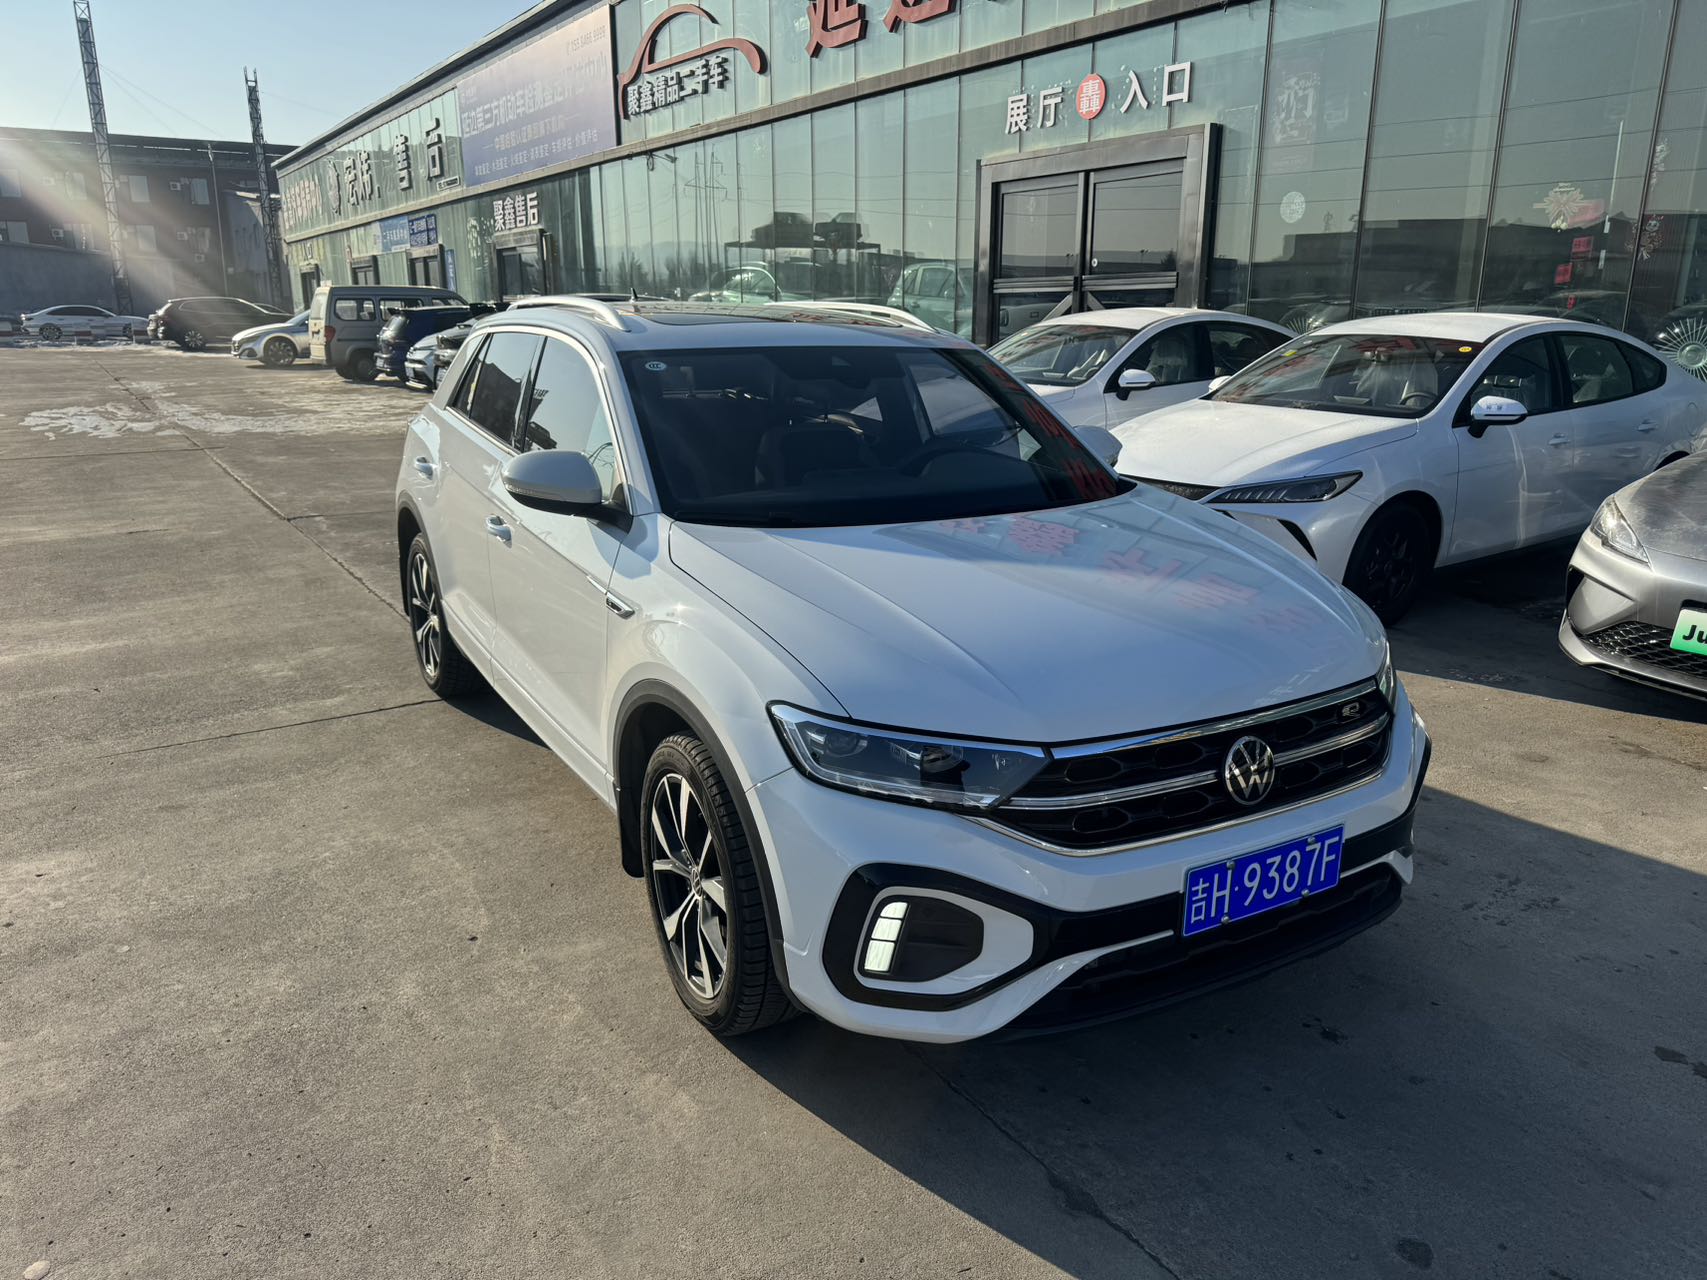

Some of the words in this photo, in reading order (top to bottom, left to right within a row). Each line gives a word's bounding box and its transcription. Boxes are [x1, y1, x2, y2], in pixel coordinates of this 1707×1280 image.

[627, 55, 728, 115] 聚鑫精品二手车
[1005, 87, 1063, 134] 展厅
[1120, 61, 1191, 115] 入口
[392, 117, 443, 191] 售后
[493, 191, 538, 231] 聚鑫售后
